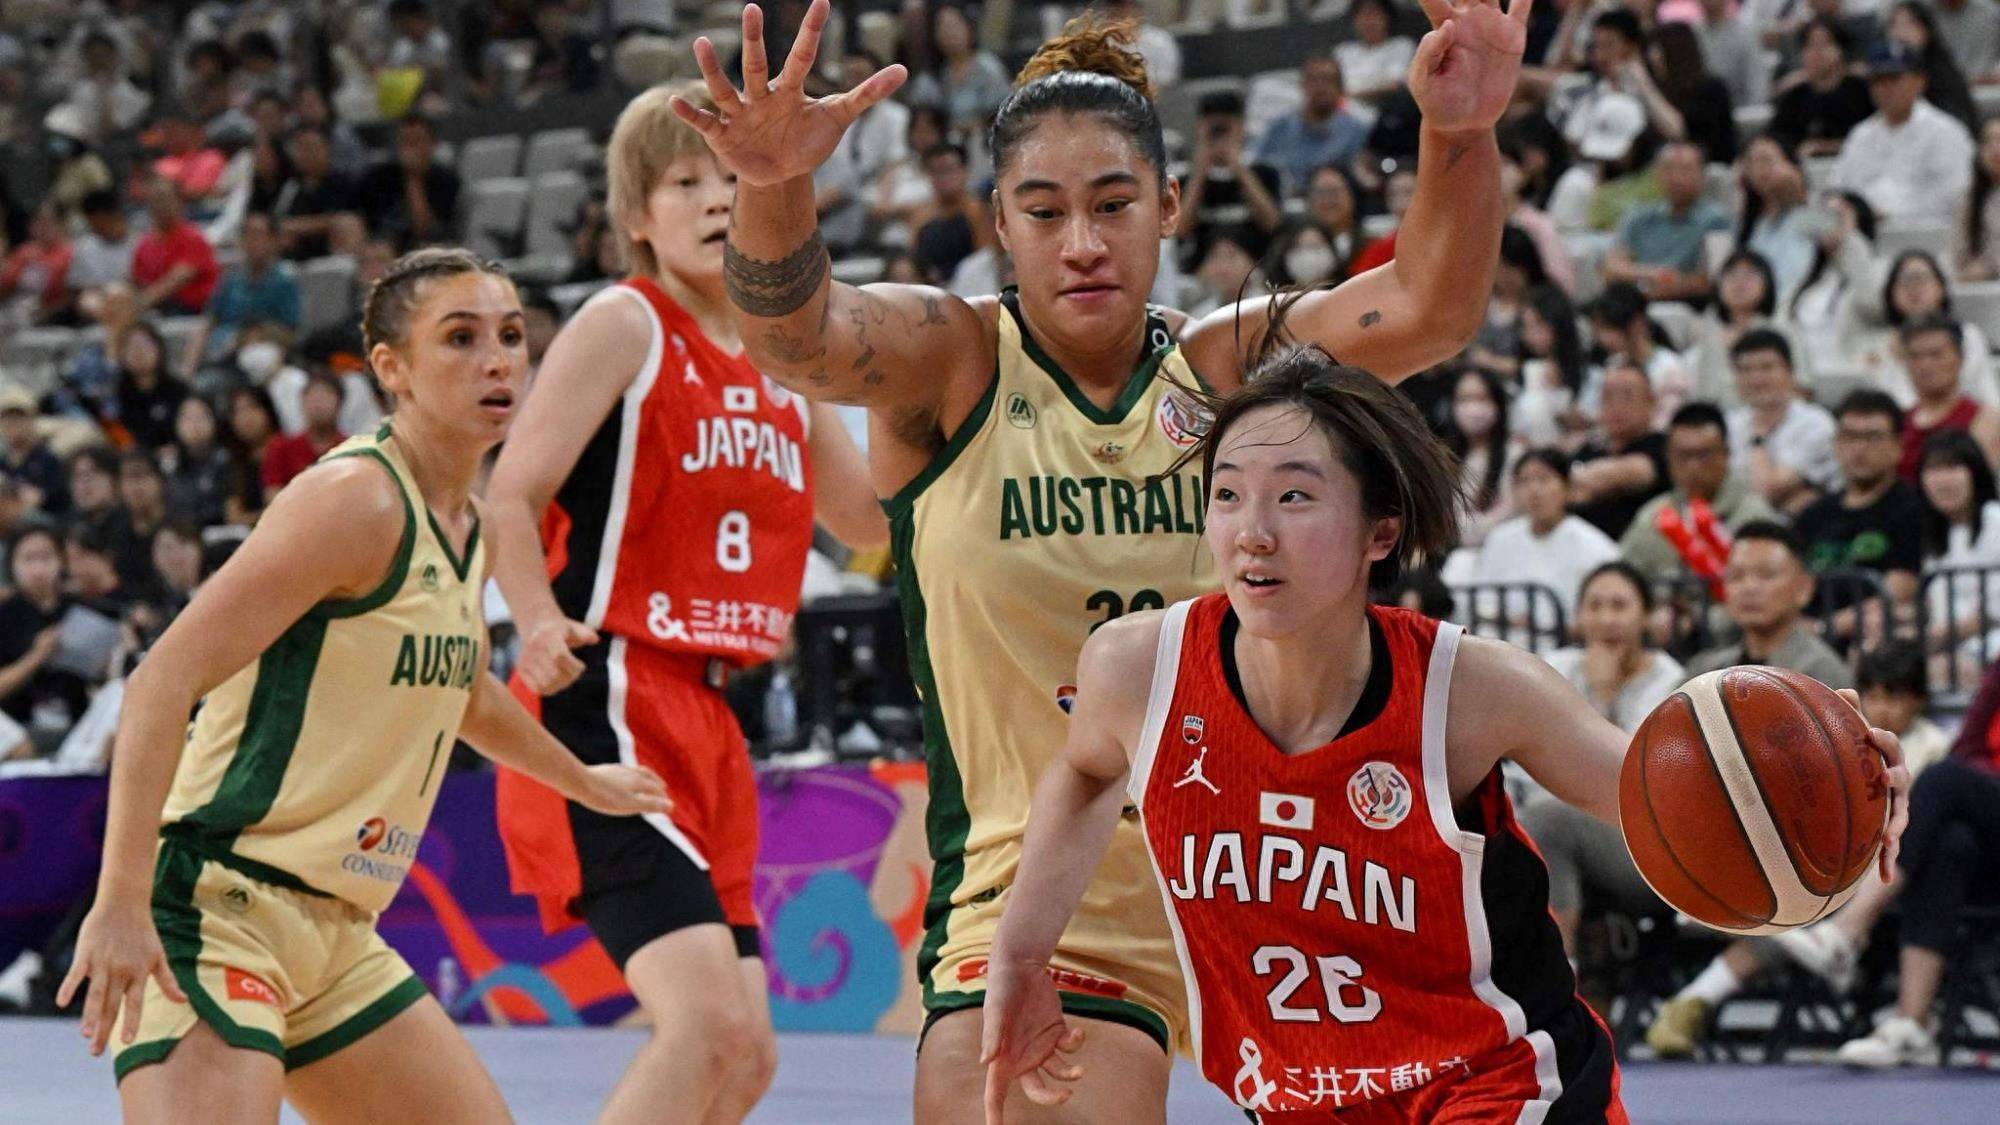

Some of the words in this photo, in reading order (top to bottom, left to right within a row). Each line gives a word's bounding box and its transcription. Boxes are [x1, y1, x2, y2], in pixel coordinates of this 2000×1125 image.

[682, 416, 805, 493] JAPAN
[716, 510, 752, 573] 8
[1169, 832, 1417, 934] JAPAN
[1252, 944, 1383, 1023] 26
